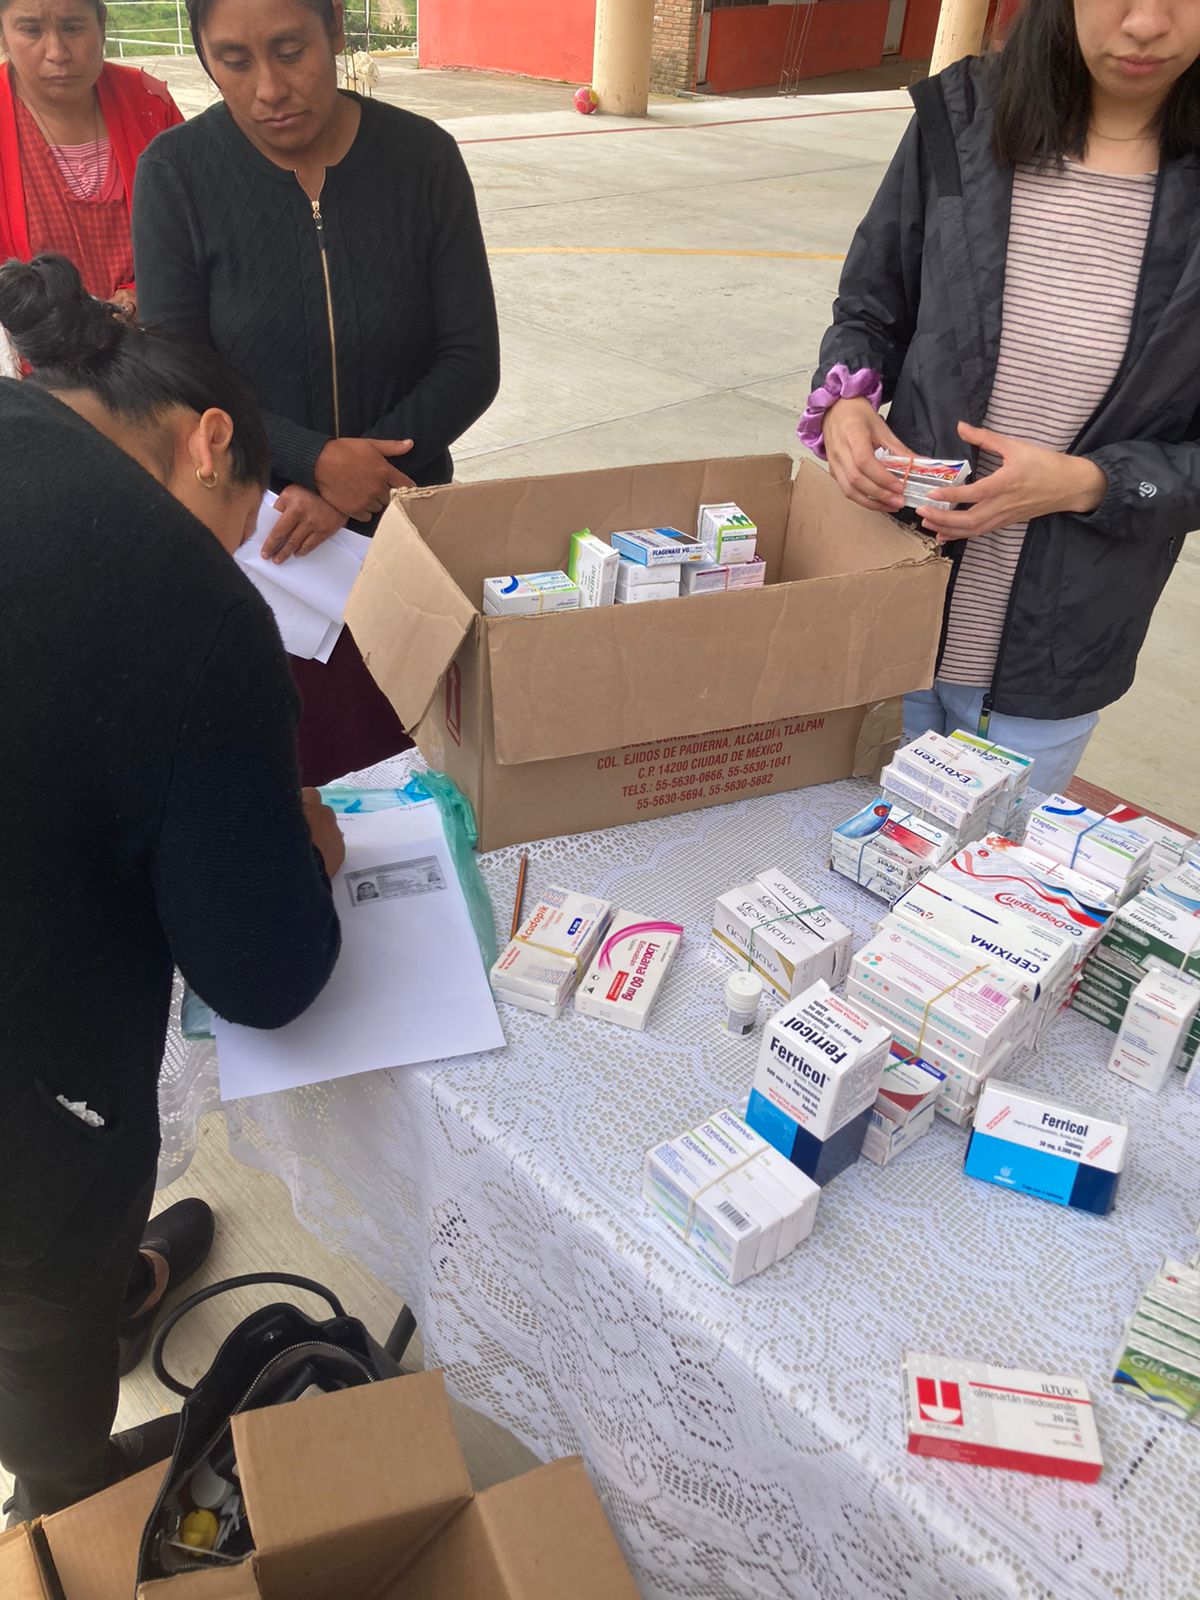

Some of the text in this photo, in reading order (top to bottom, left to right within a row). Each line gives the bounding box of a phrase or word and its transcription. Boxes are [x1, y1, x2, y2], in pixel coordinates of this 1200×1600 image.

[597, 756, 620, 770] COL.
[624, 749, 660, 766] EJIDOS
[663, 746, 677, 759] DE
[679, 737, 731, 757] PADIERNA,
[783, 717, 825, 737] TLALPAN
[658, 761, 689, 776] 14200
[691, 754, 728, 770] CIUDAD
[731, 751, 744, 763] DE
[746, 741, 783, 759] MÉXICO
[727, 755, 792, 777] 55-5630-1041
[913, 748, 972, 784] Exbuten
[708, 773, 773, 796] 55-5630-5682
[519, 905, 549, 941] Acudopik
[1129, 912, 1178, 942] Alzoprim
[622, 942, 660, 1002] Lixiana 60 mg
[970, 934, 1041, 975] CEFIXIMA
[783, 1017, 848, 1065] Ferricol
[770, 1036, 826, 1088] Ferricol
[1041, 1112, 1089, 1137] Ferricol
[973, 1389, 1077, 1412] olmesartán medoxomilo
[1041, 1383, 1073, 1396] ILTUX
